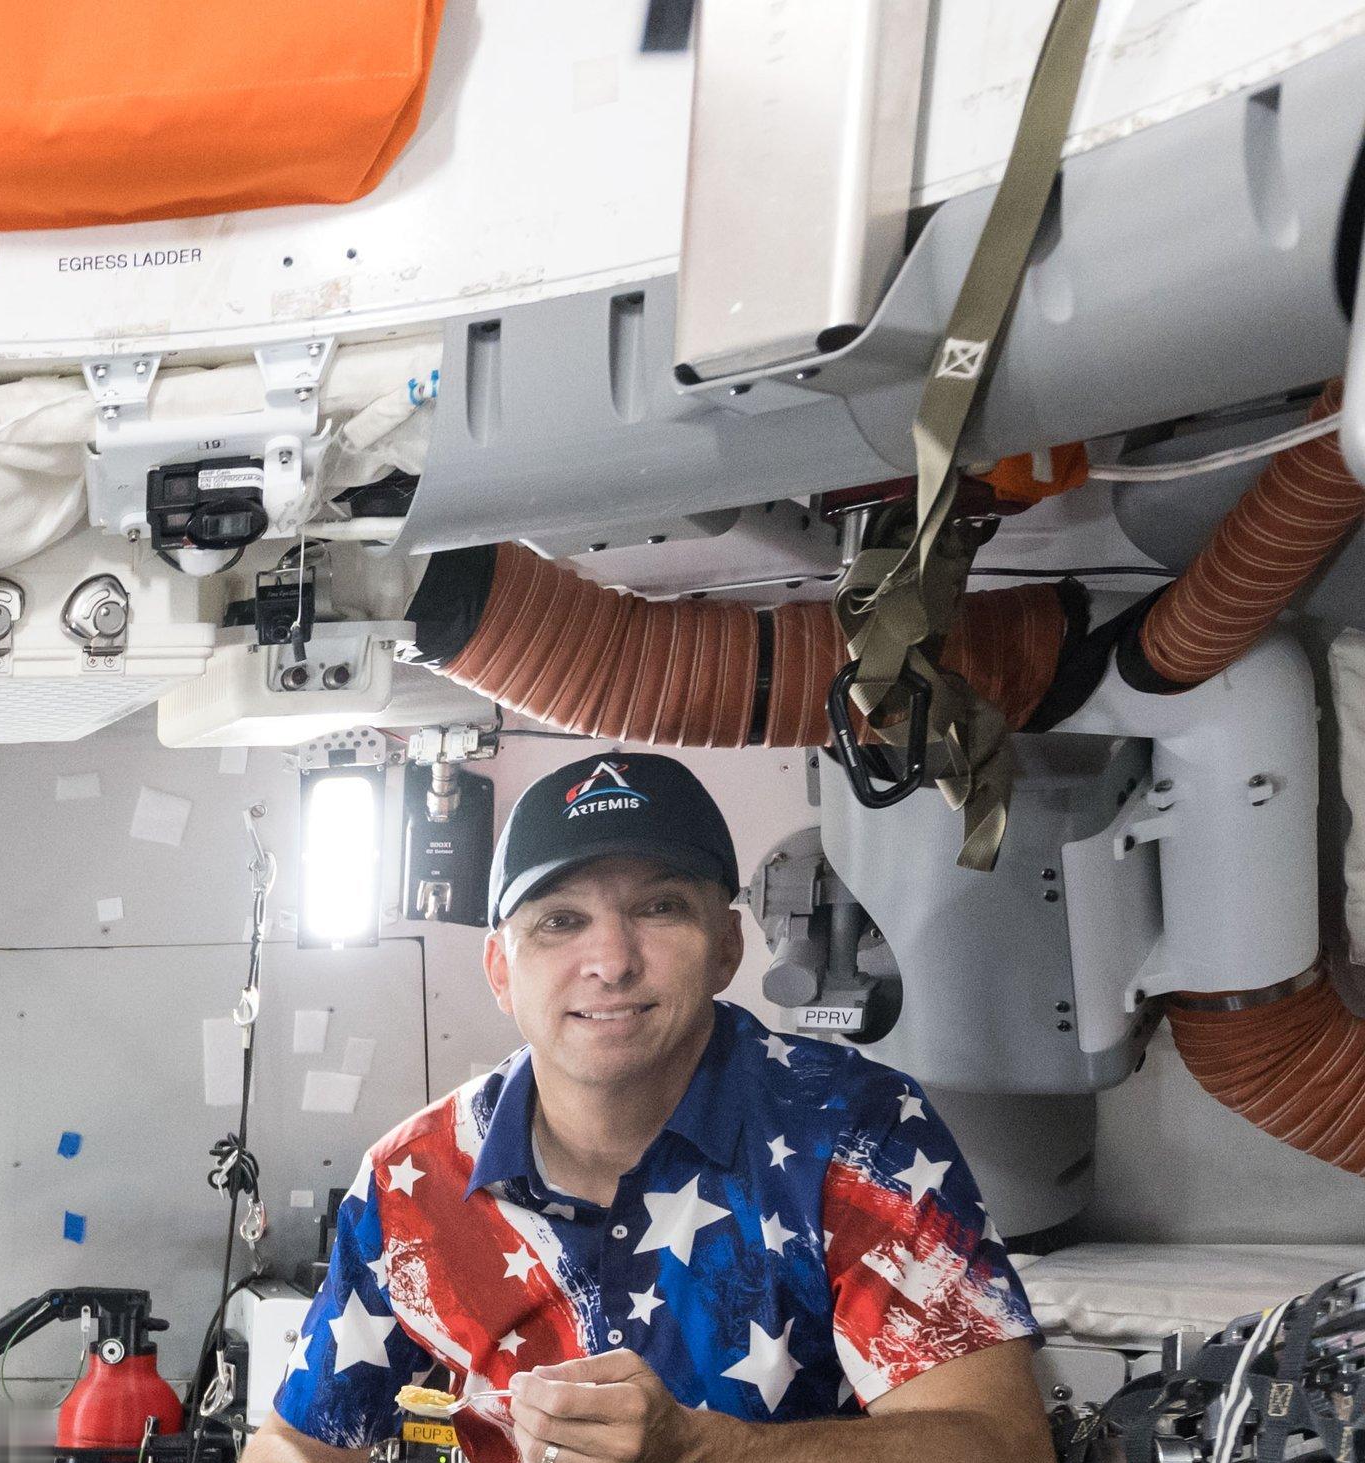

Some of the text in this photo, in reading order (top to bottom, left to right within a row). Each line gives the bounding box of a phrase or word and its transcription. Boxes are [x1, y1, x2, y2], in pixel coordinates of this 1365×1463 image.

[58, 248, 202, 272] EGRESS LADDER
[203, 439, 221, 450] 19
[568, 798, 640, 819] ARTEMIS
[805, 1010, 853, 1025] PPRV
[413, 1426, 454, 1442] PUP 3
